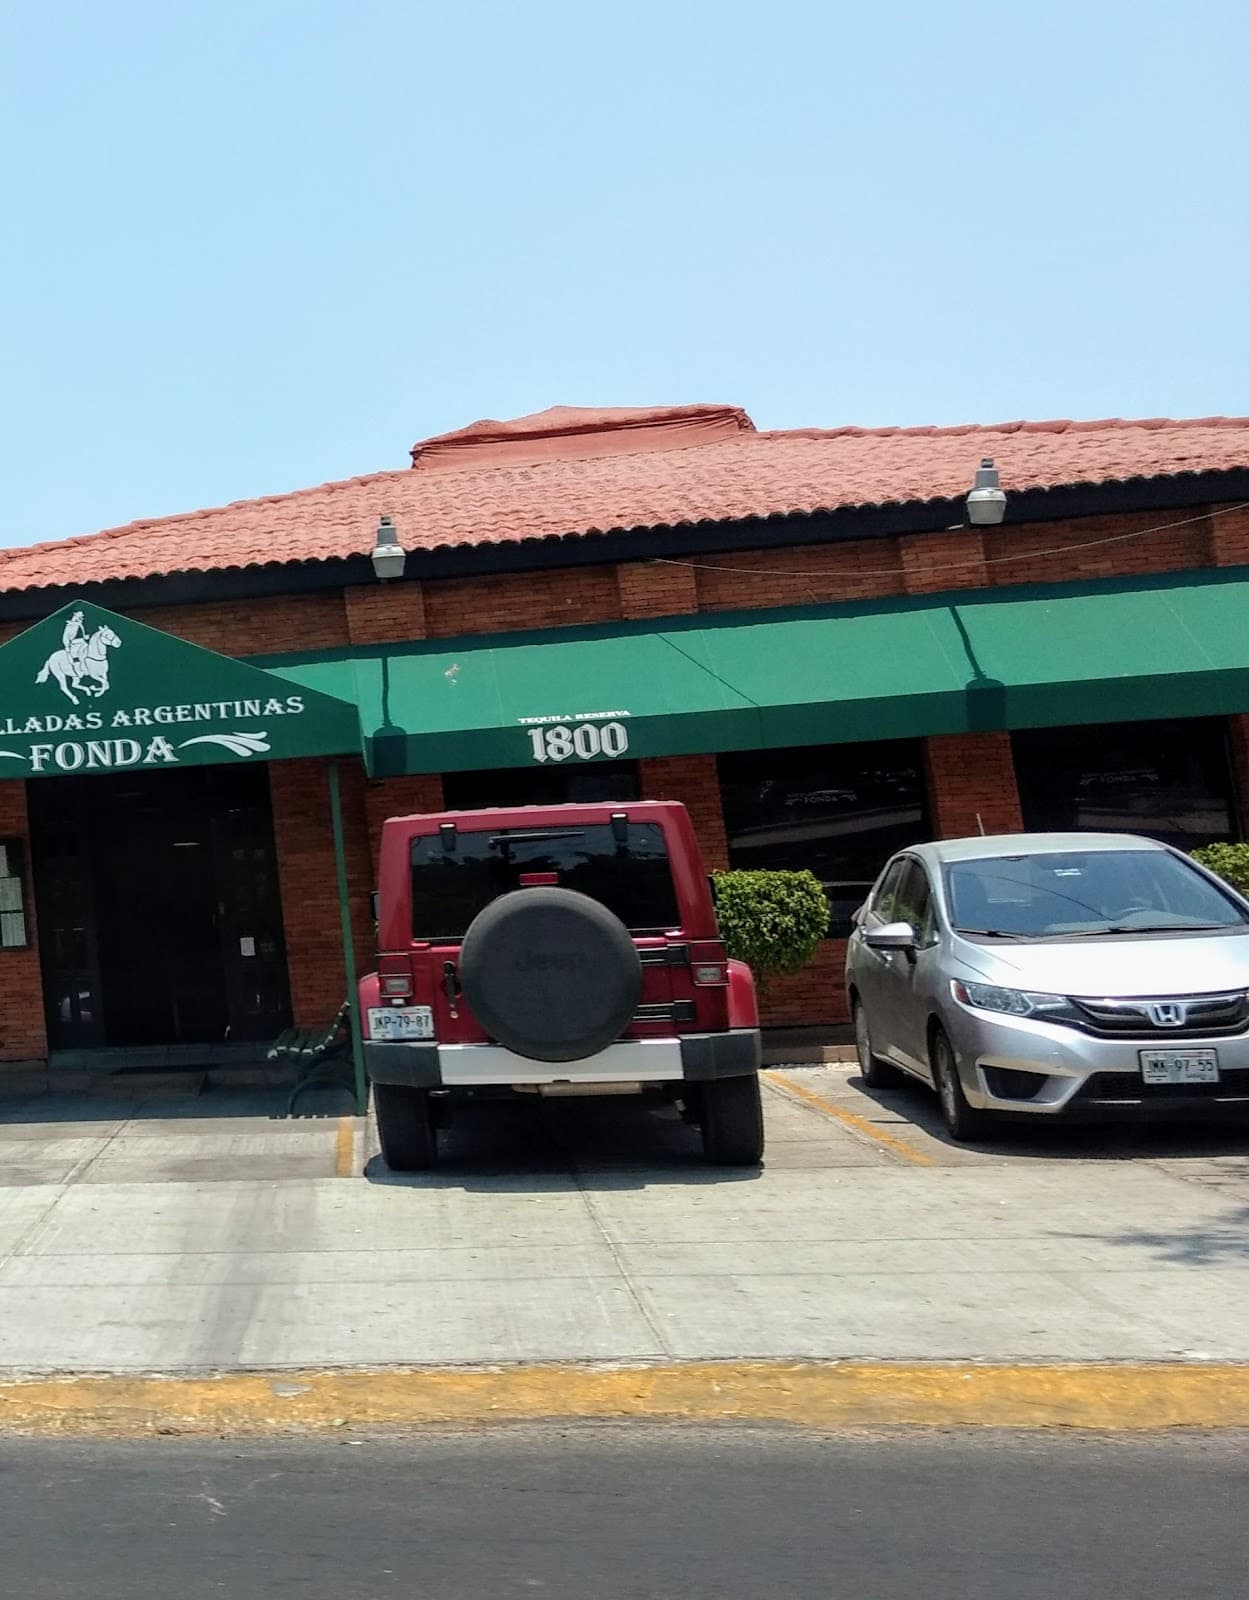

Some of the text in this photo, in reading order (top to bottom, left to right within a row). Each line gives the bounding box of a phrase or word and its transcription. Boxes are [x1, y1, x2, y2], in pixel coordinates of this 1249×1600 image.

[110, 696, 305, 728] ARGENTINAS
[516, 710, 631, 724] TEQUILA RESERVA
[28, 735, 181, 772] FONDA
[527, 722, 629, 762] 1800
